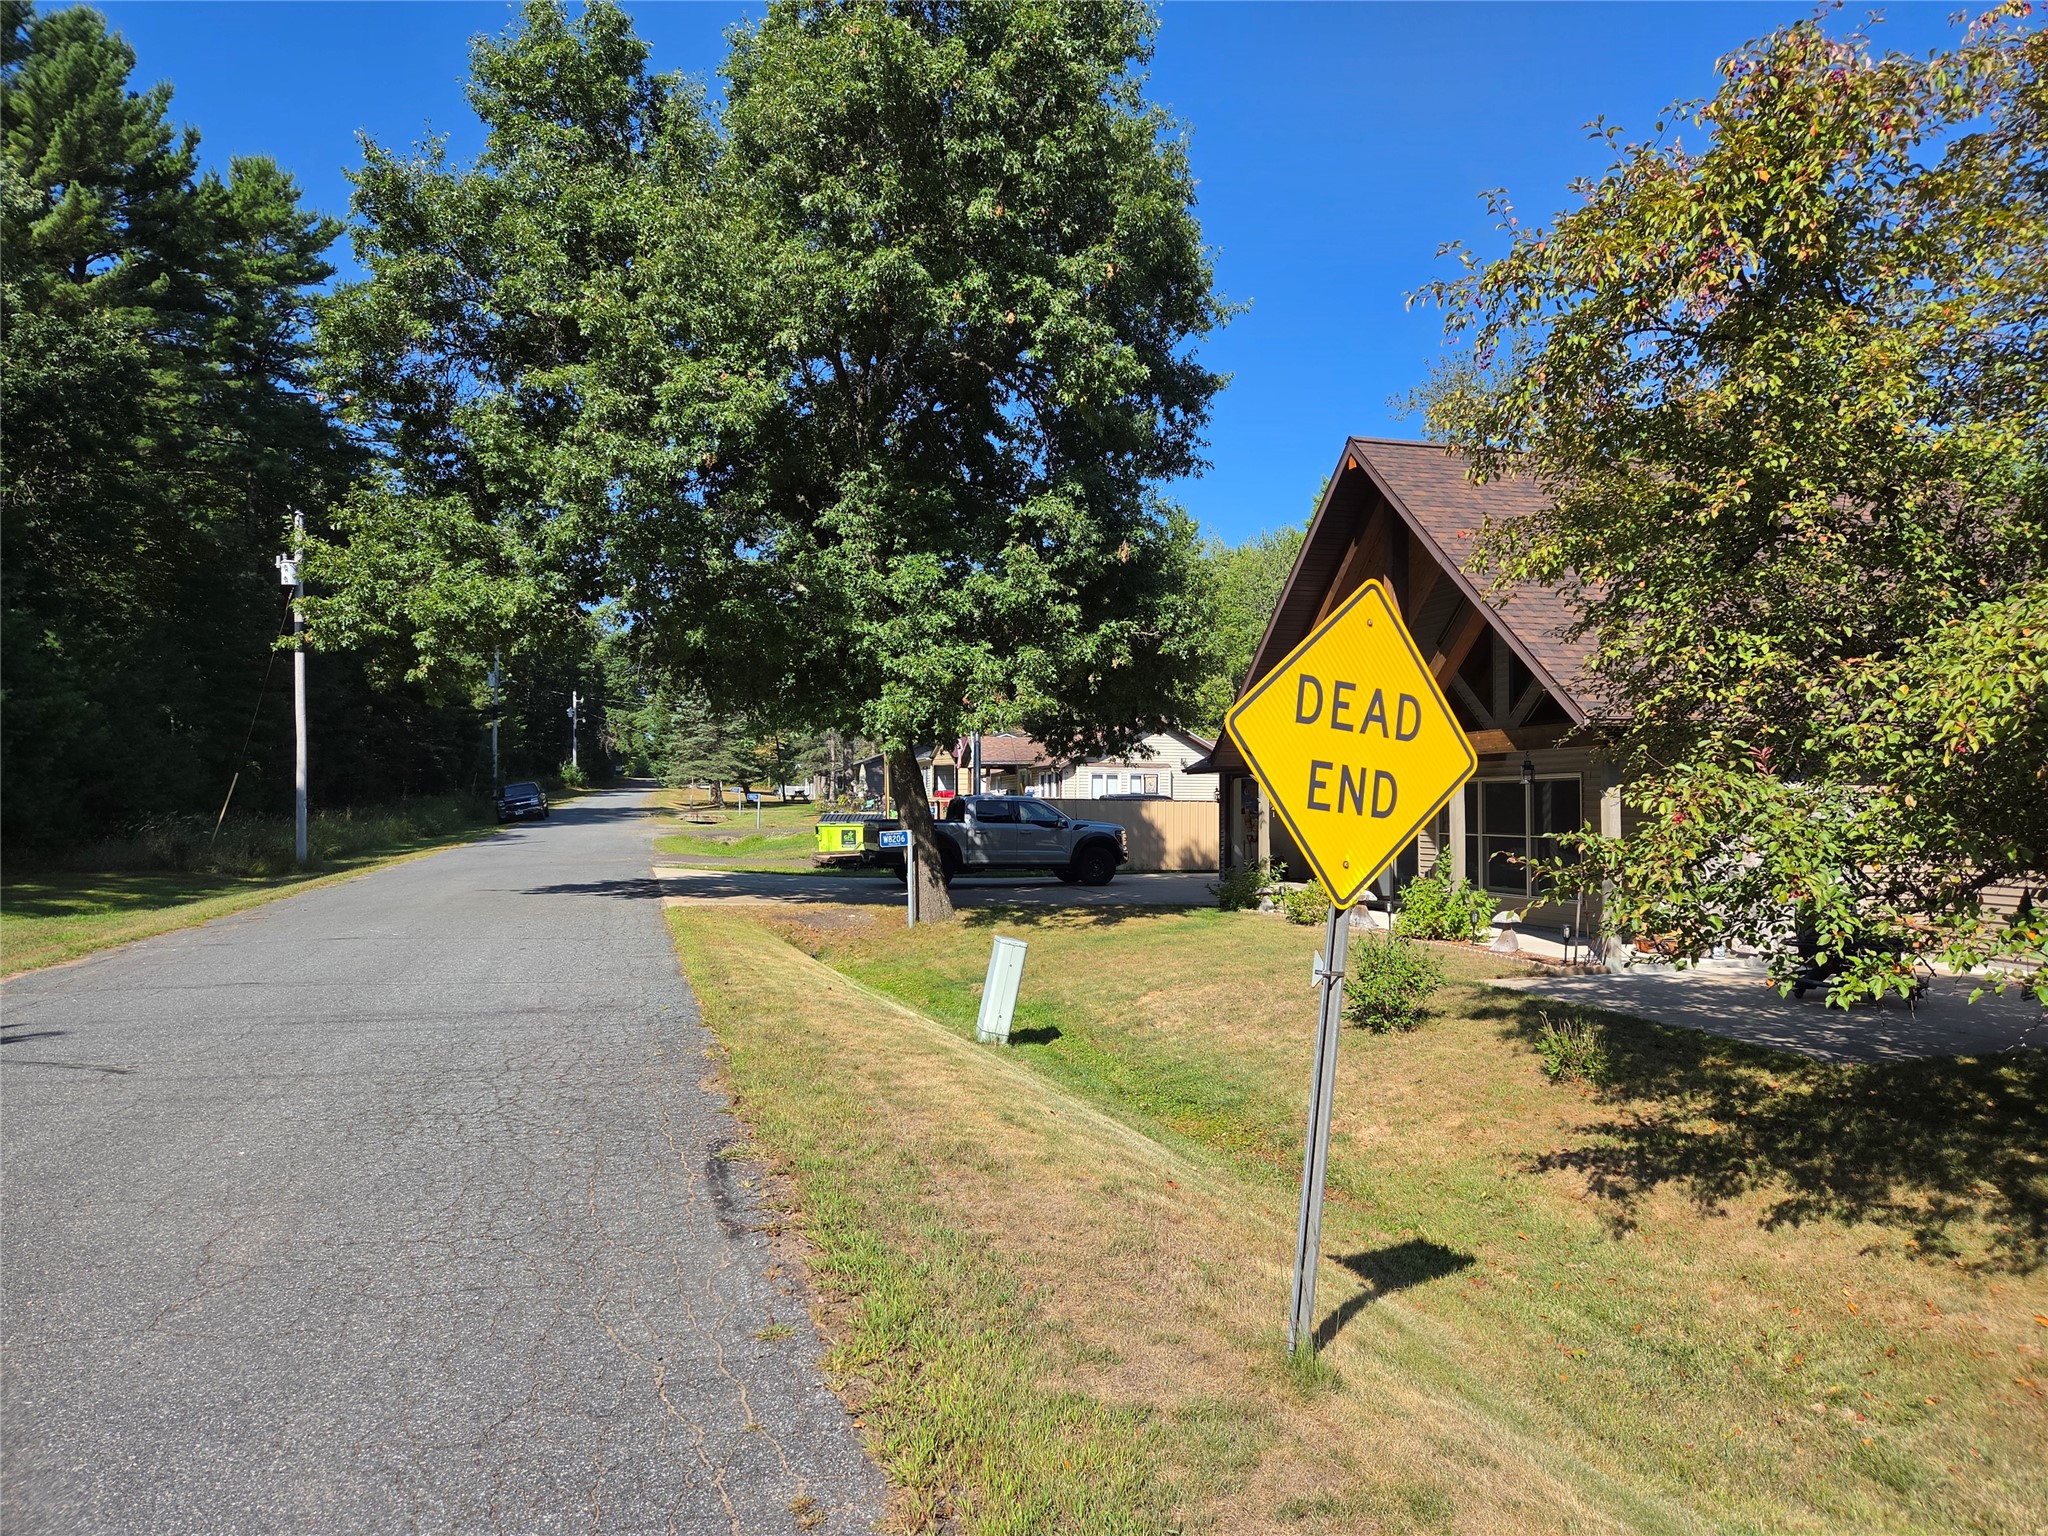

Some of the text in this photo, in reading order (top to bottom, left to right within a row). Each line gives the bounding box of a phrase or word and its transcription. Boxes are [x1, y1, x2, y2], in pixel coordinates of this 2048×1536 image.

[1295, 673, 1422, 742] DEAD
[1307, 759, 1398, 819] END
[883, 834, 906, 844] W8206
